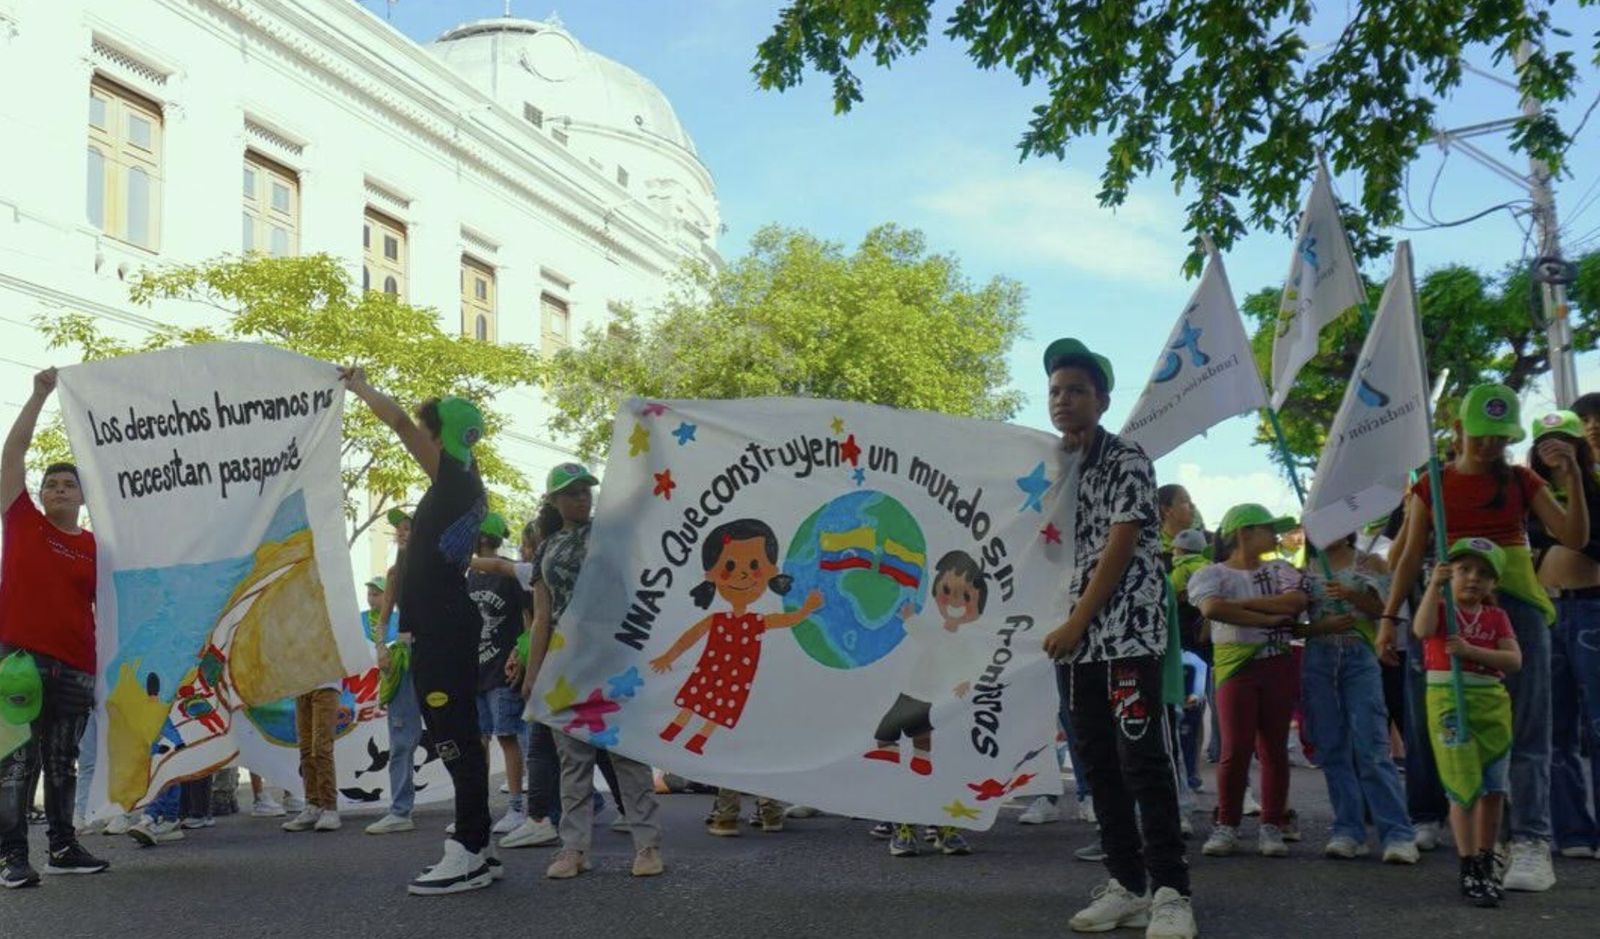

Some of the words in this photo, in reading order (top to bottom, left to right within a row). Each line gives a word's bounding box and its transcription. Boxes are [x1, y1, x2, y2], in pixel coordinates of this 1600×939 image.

[87, 409, 123, 446] Los
[124, 399, 212, 441] derechos
[214, 390, 310, 429] humanos
[117, 447, 213, 499] necesitan
[219, 436, 302, 499] pasaporte
[867, 445, 900, 475] un
[908, 456, 991, 542] mundo
